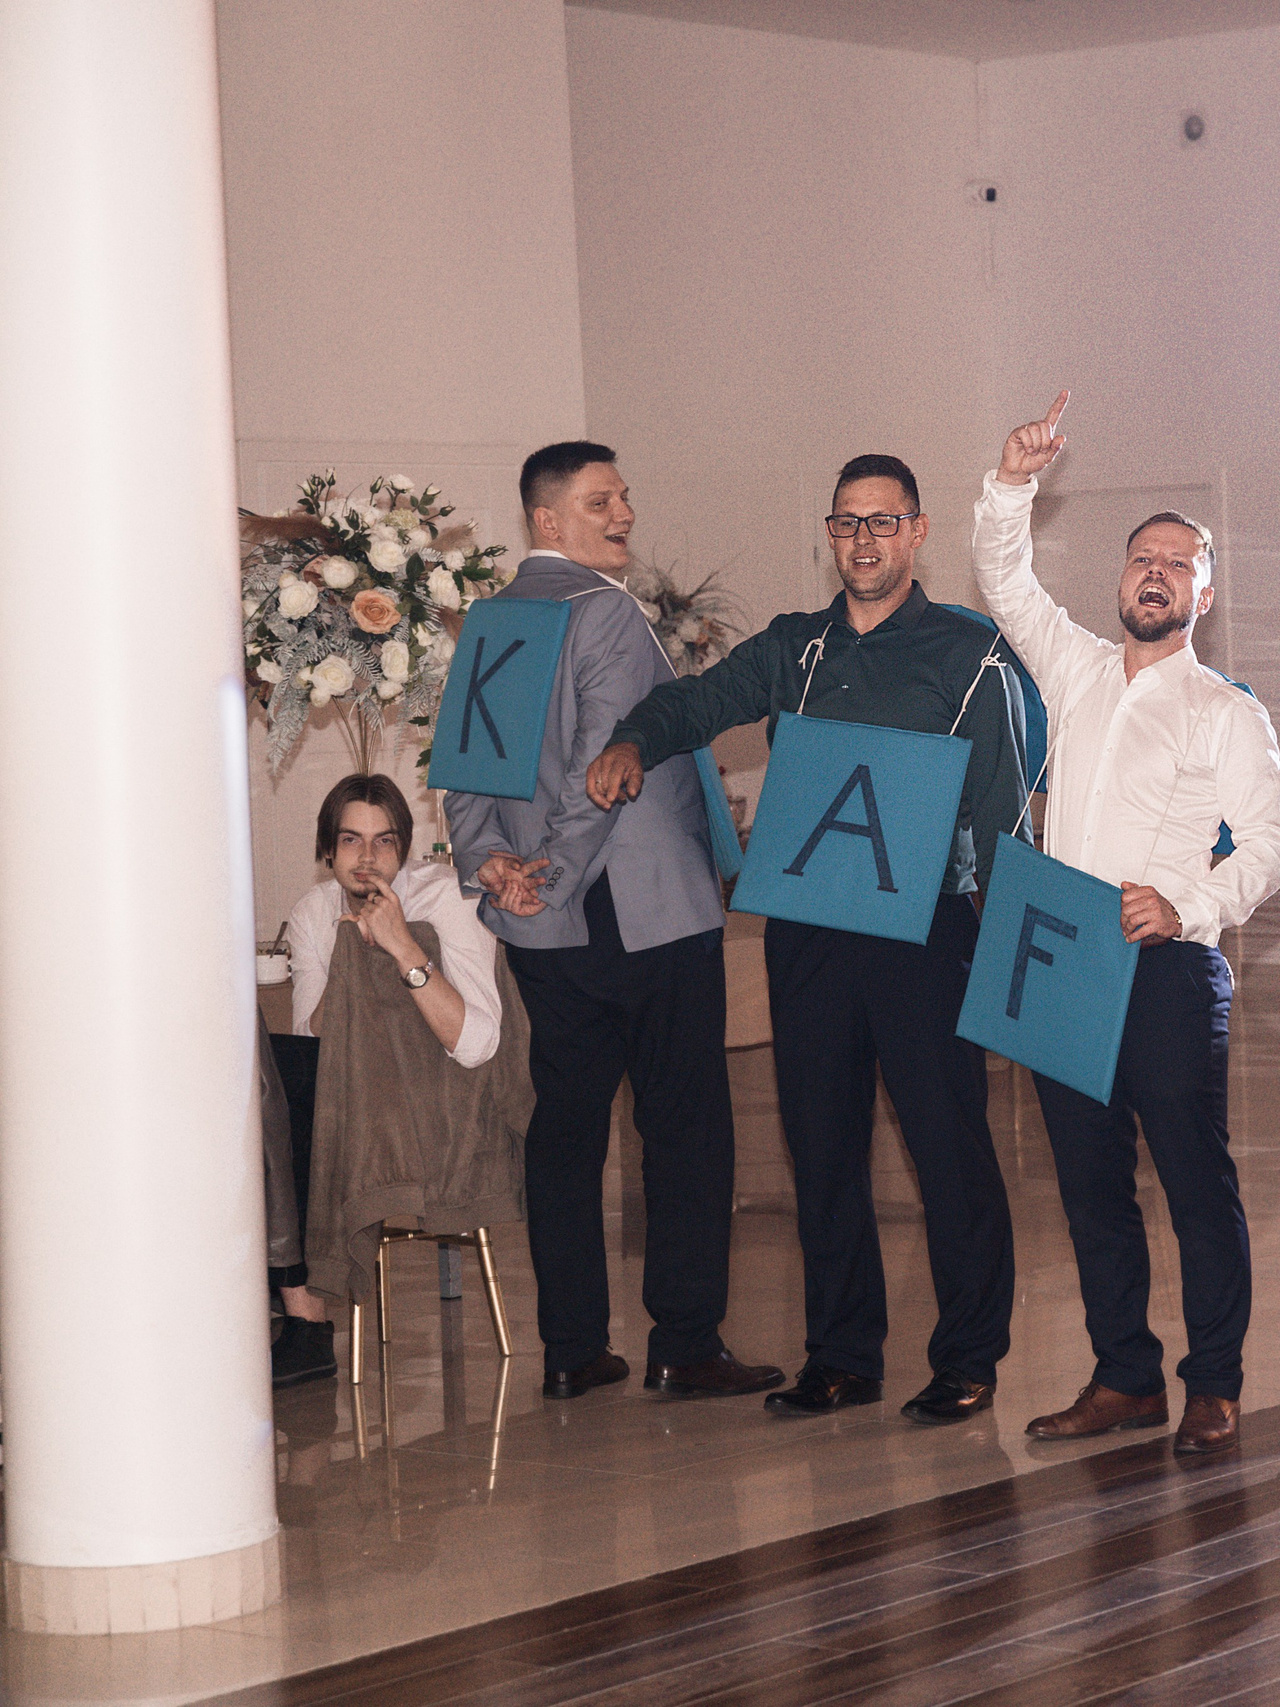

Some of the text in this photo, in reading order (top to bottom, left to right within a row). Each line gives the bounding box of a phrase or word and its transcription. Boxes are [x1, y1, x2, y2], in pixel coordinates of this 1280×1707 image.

[459, 637, 525, 759] K
[783, 764, 899, 893] A
[1005, 903, 1079, 1021] F
